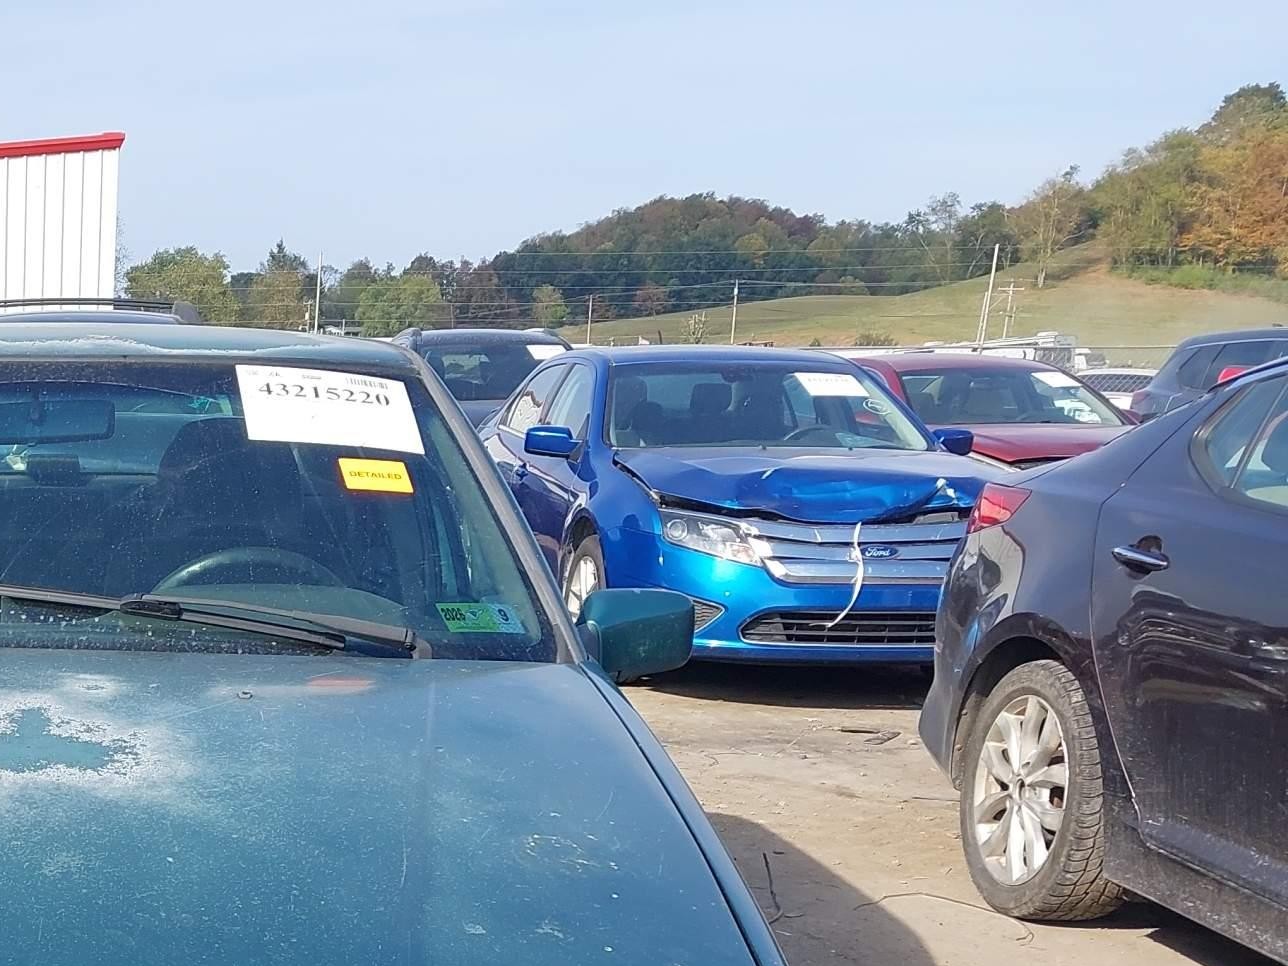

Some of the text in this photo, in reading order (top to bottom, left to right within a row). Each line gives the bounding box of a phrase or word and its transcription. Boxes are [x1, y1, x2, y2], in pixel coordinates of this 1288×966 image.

[258, 382, 391, 406] 43215220
[349, 470, 402, 481] DETAILED
[865, 546, 891, 557] Ford
[497, 608, 510, 622] 9
